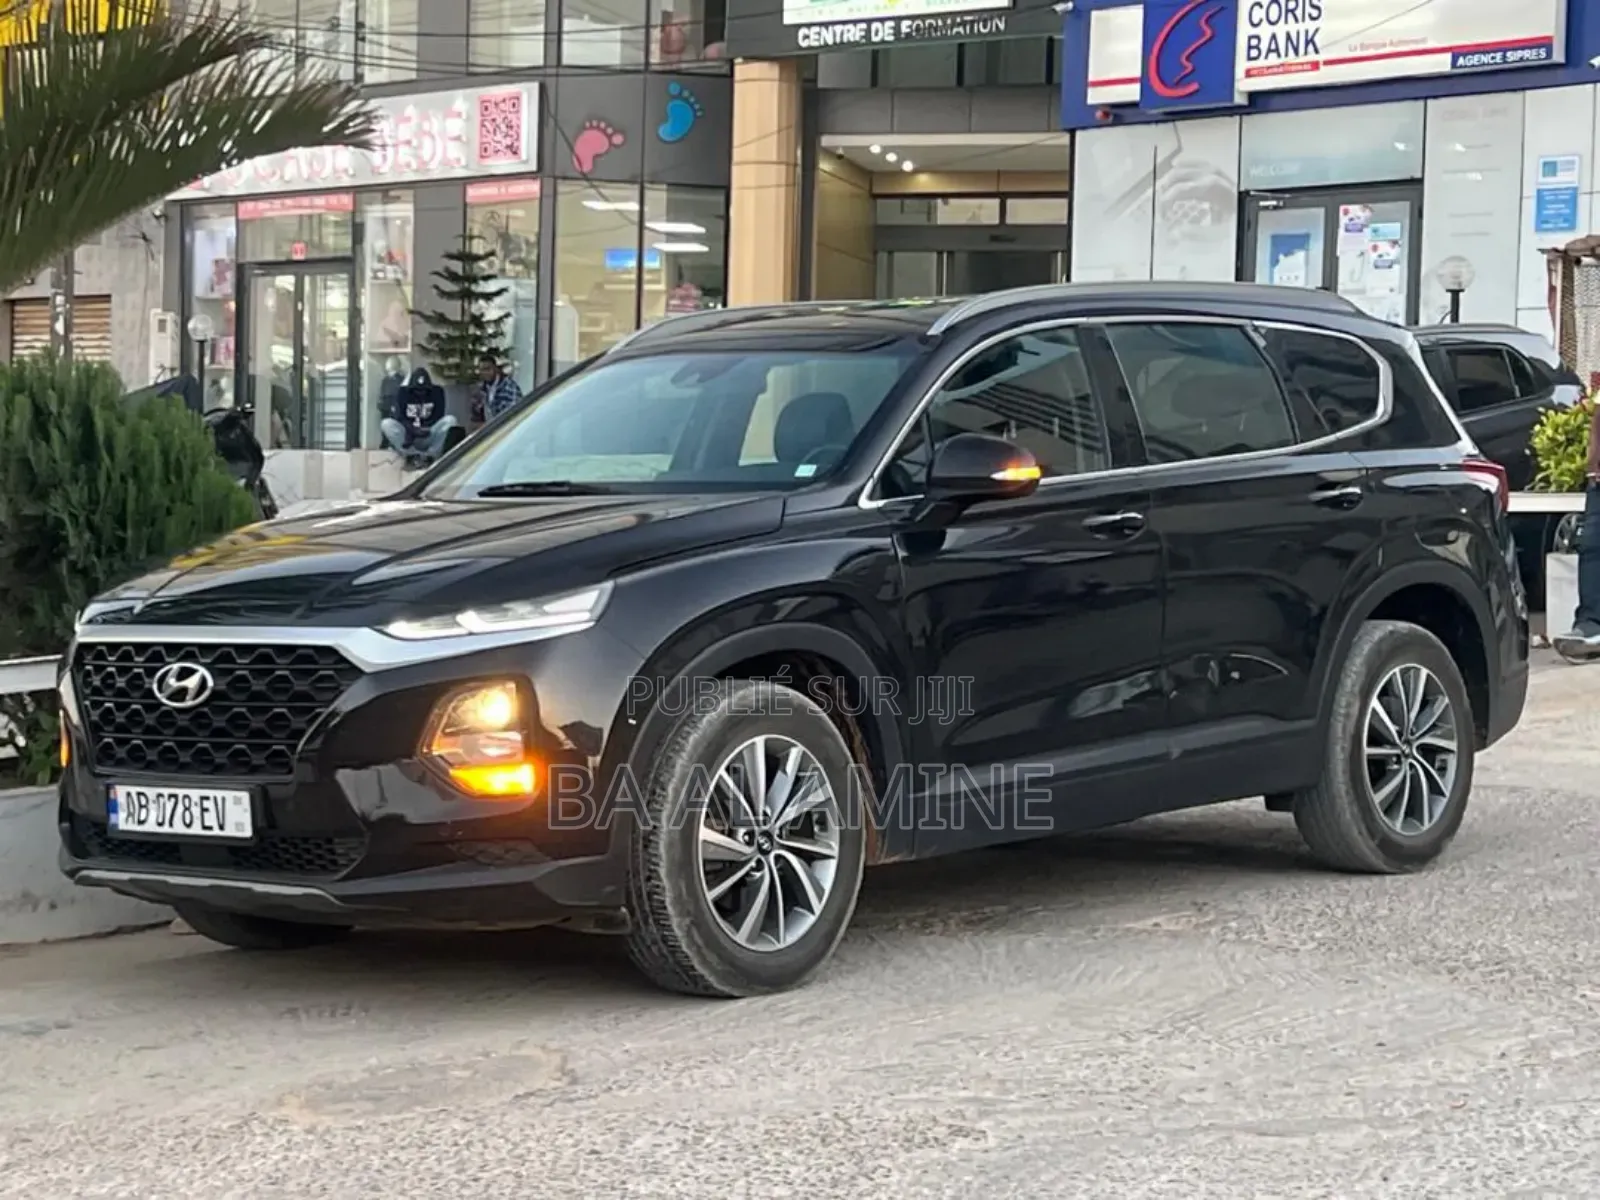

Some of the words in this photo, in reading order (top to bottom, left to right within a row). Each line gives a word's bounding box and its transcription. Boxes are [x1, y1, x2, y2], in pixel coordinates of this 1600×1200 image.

[1248, 0, 1323, 28] CORIS
[797, 22, 868, 49] CENTRE
[871, 21, 896, 43] DE
[900, 15, 1007, 39] FORMATION
[1246, 27, 1321, 62] BANK
[1456, 50, 1504, 68] AGENCE
[1505, 47, 1548, 63] SIPRES
